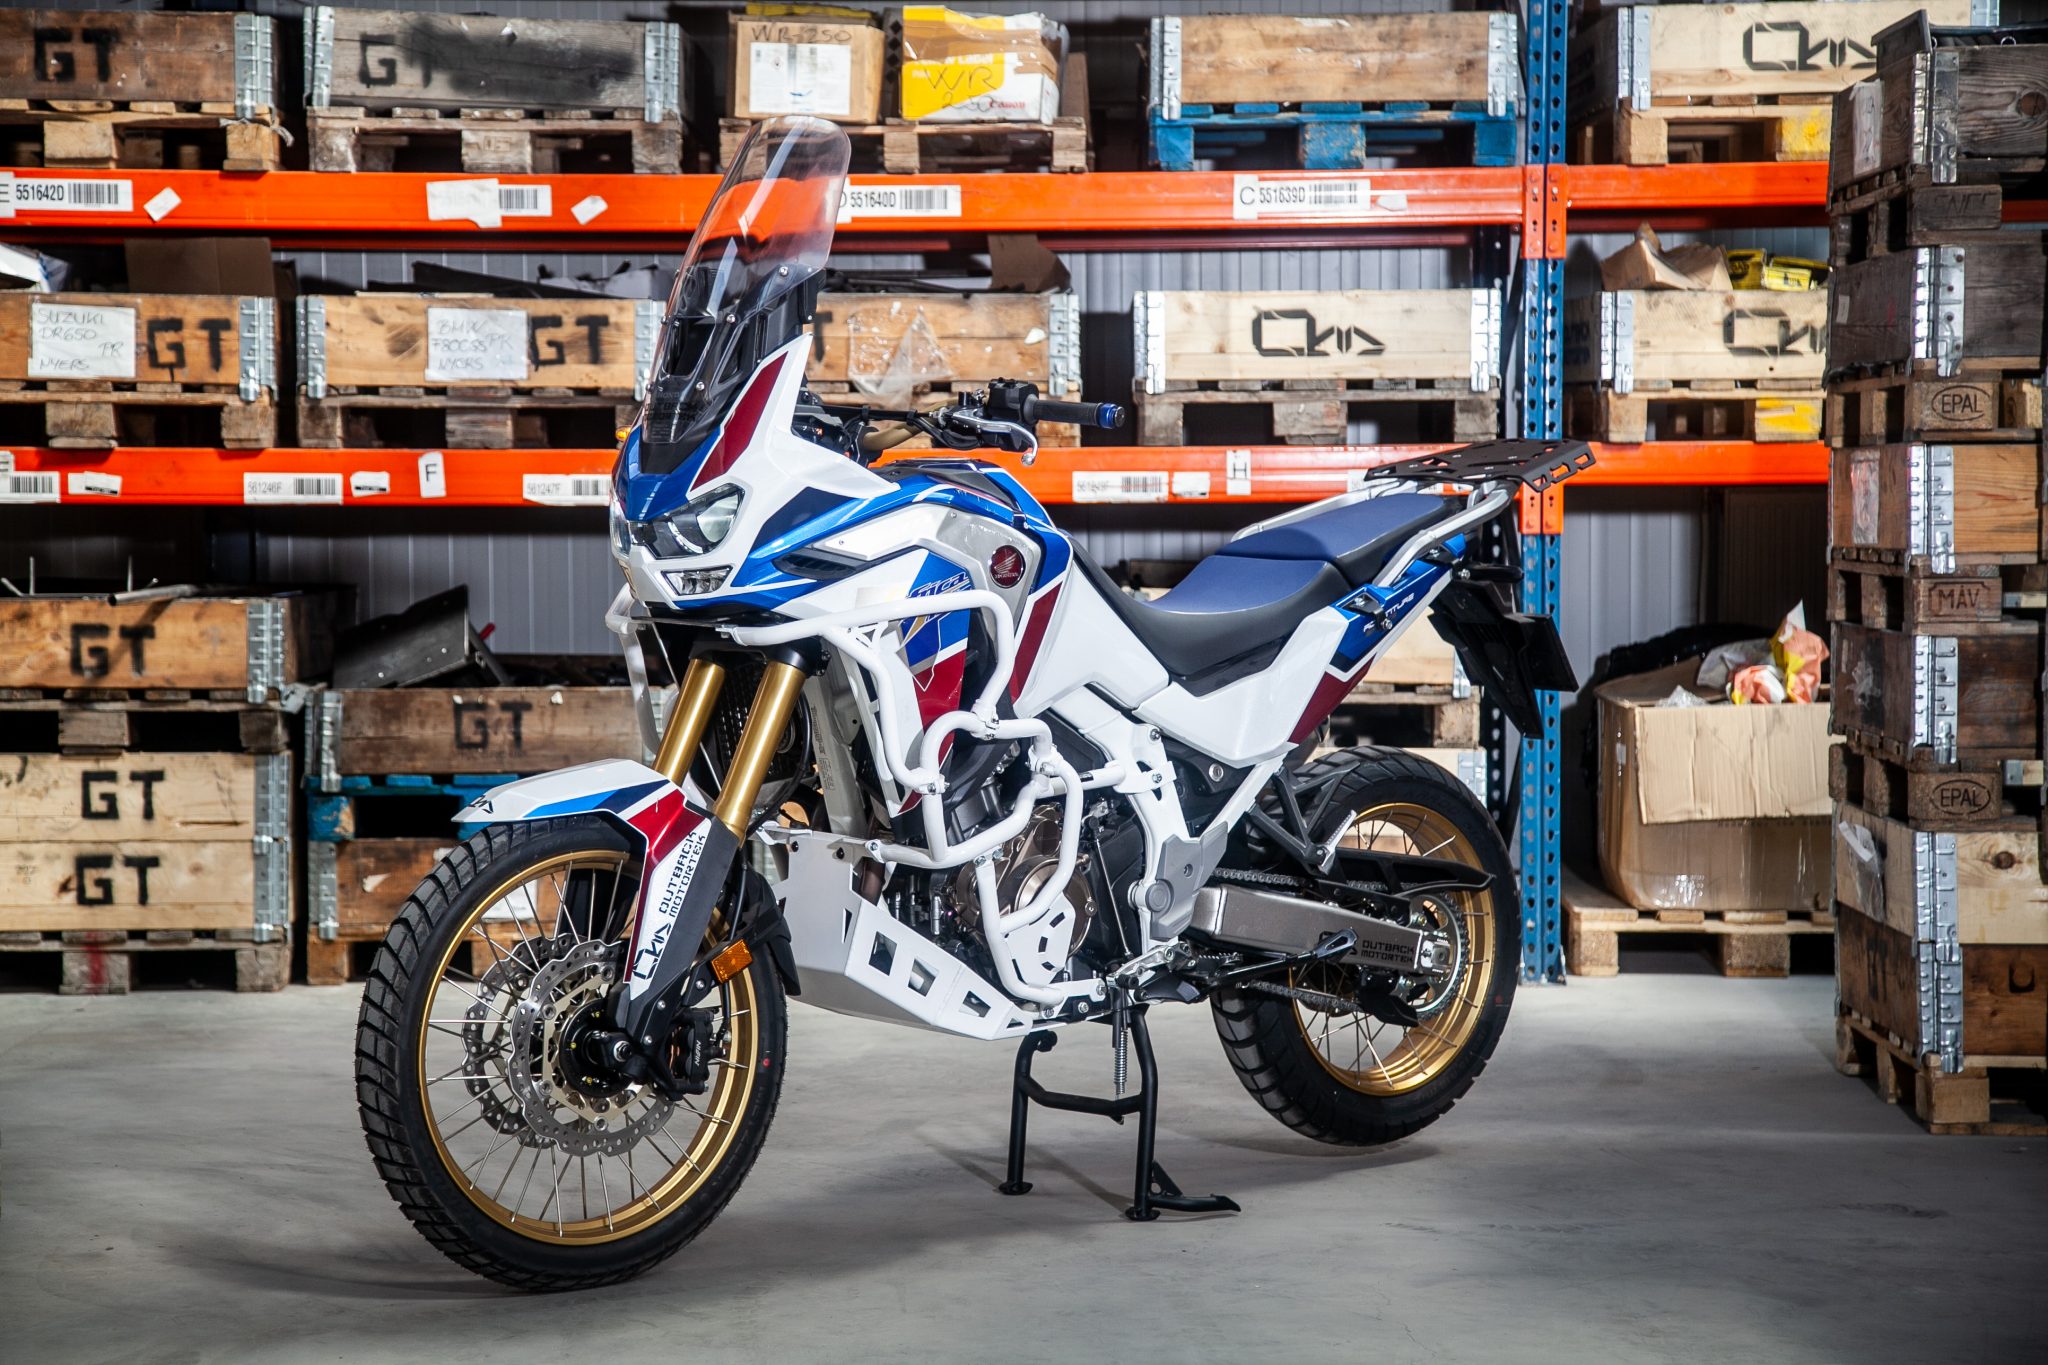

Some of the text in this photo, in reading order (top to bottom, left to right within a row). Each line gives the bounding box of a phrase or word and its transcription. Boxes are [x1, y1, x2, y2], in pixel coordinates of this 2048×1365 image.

[35, 29, 119, 82] GT
[1239, 186, 1256, 206] C
[147, 318, 231, 372] GT
[531, 315, 609, 368] GT
[1941, 393, 1983, 413] EPAL
[425, 463, 438, 482] F
[1233, 462, 1248, 480] H
[70, 622, 155, 677] GT
[454, 700, 533, 750] GT
[81, 770, 165, 820] GT
[1940, 788, 1983, 808] EPAL
[75, 855, 160, 906] GT
[1360, 949, 1413, 963] MOTORTEK
[1362, 939, 1414, 955] OUTBACK
